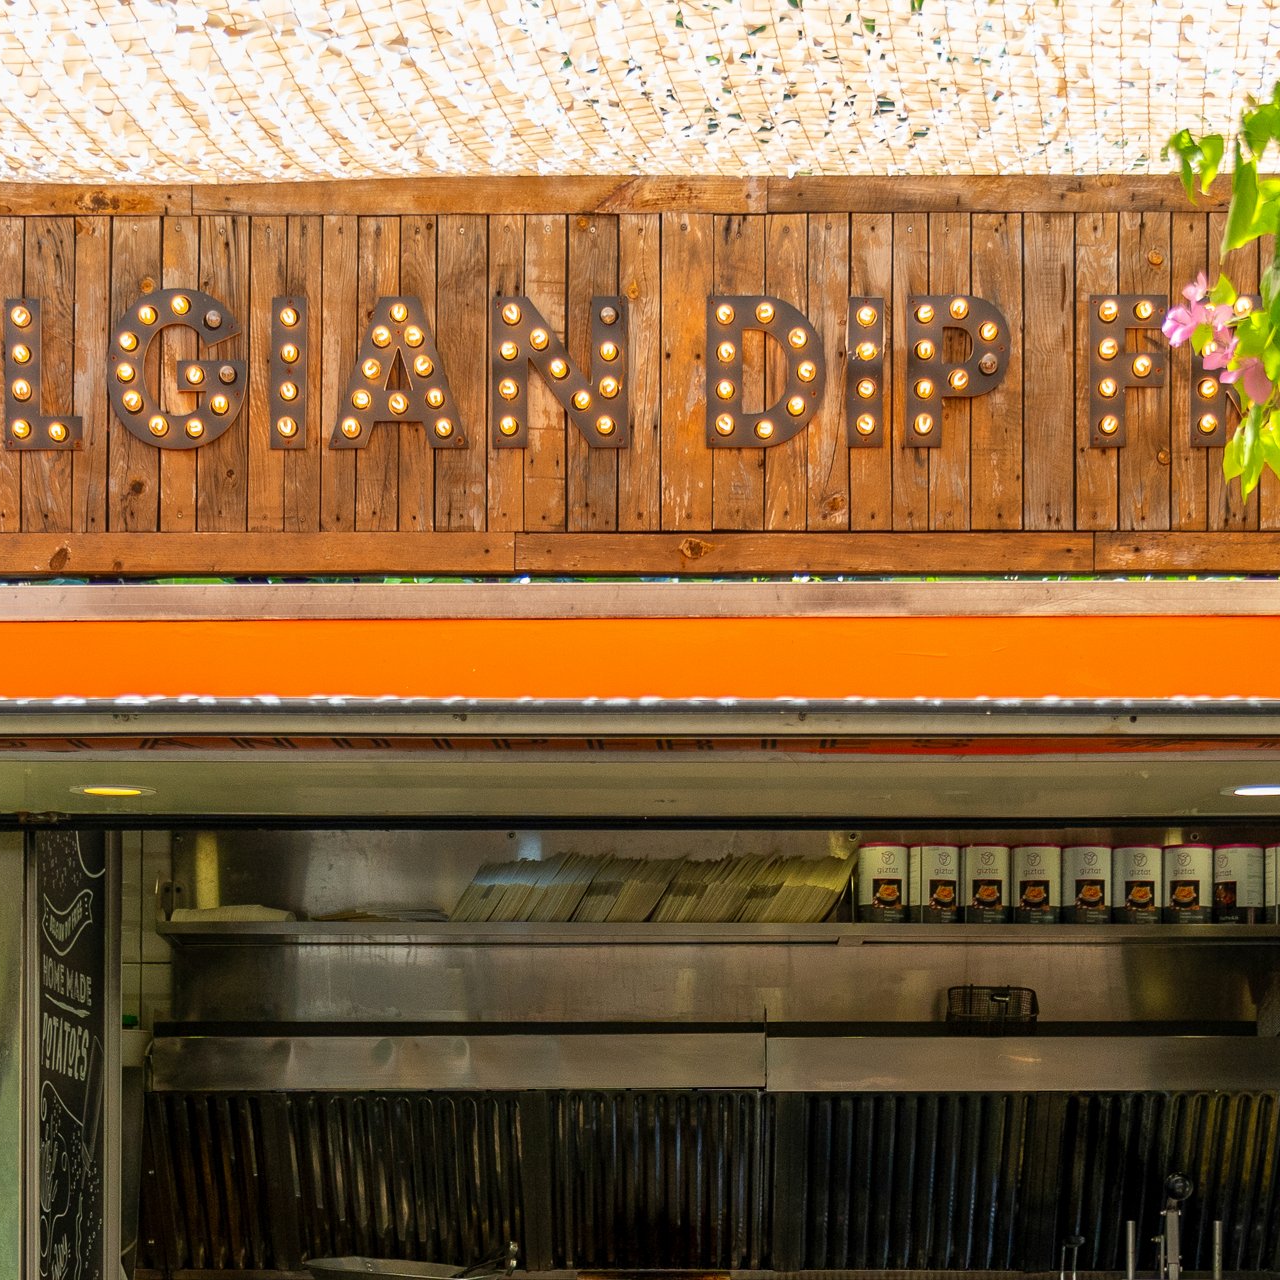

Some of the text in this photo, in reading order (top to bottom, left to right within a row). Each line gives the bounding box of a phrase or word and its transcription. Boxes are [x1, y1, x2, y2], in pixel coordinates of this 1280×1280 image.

[705, 294, 1011, 449] DIP
[42, 953, 92, 1007] HOME MADE
[41, 1012, 90, 1082] POTATOES
